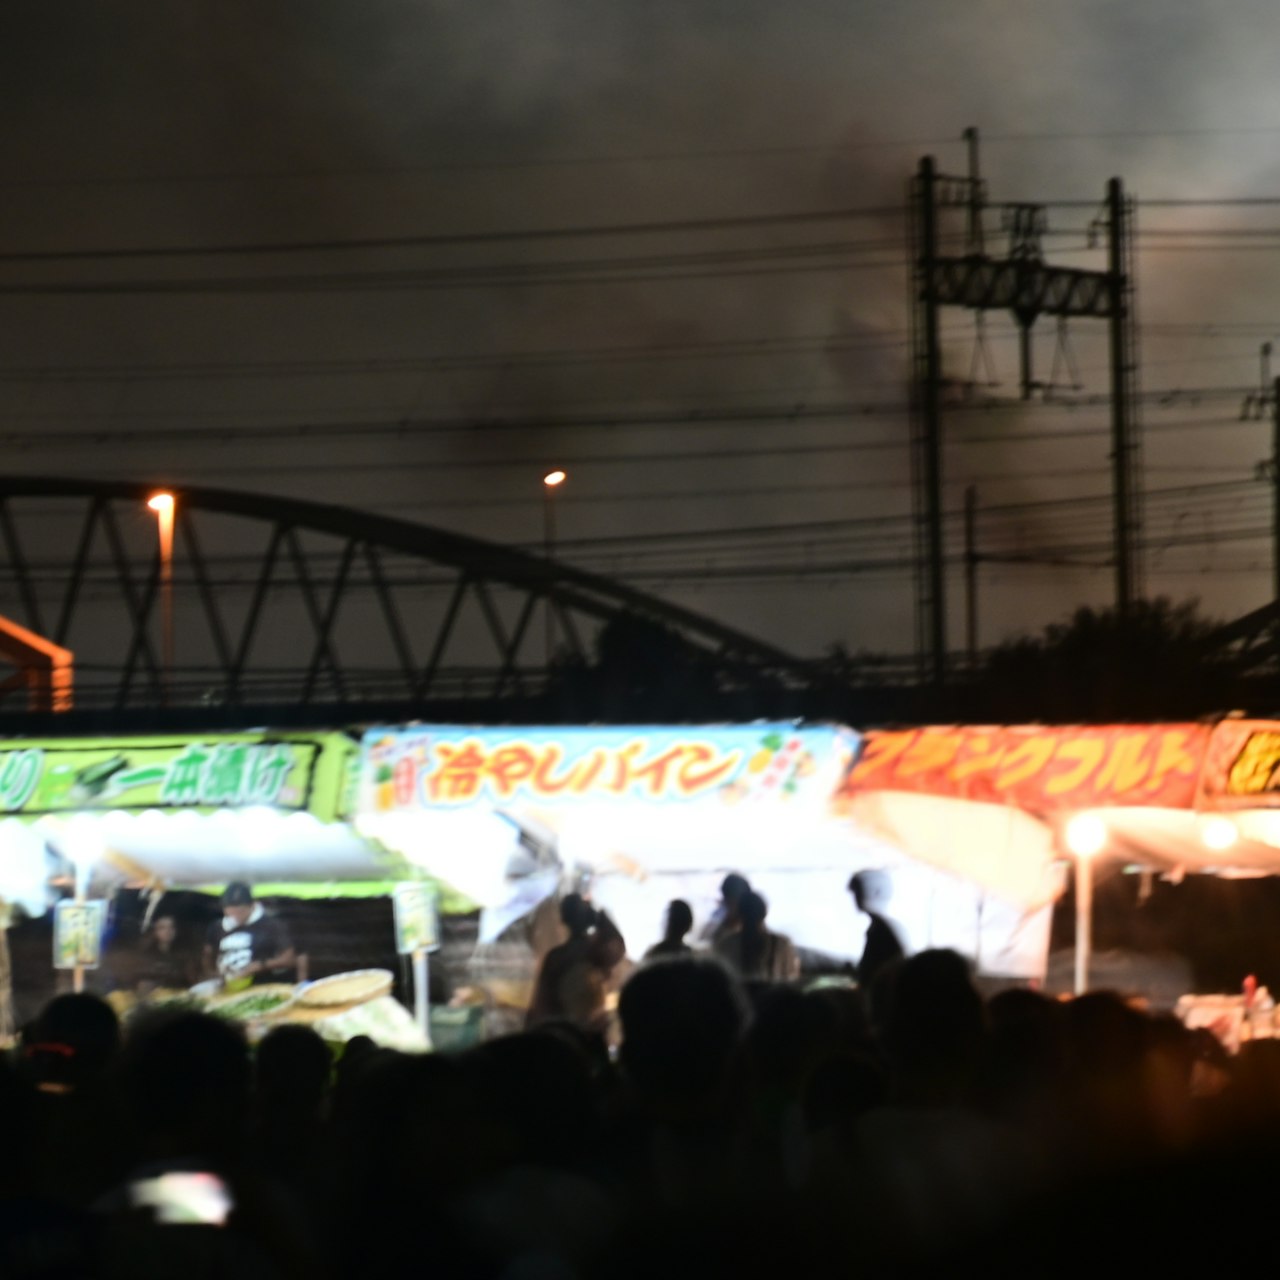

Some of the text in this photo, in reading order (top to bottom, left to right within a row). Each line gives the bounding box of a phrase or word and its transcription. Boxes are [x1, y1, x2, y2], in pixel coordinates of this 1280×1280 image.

[425, 739, 738, 799] 冷やしパイン
[849, 730, 1195, 796] フランクフルト
